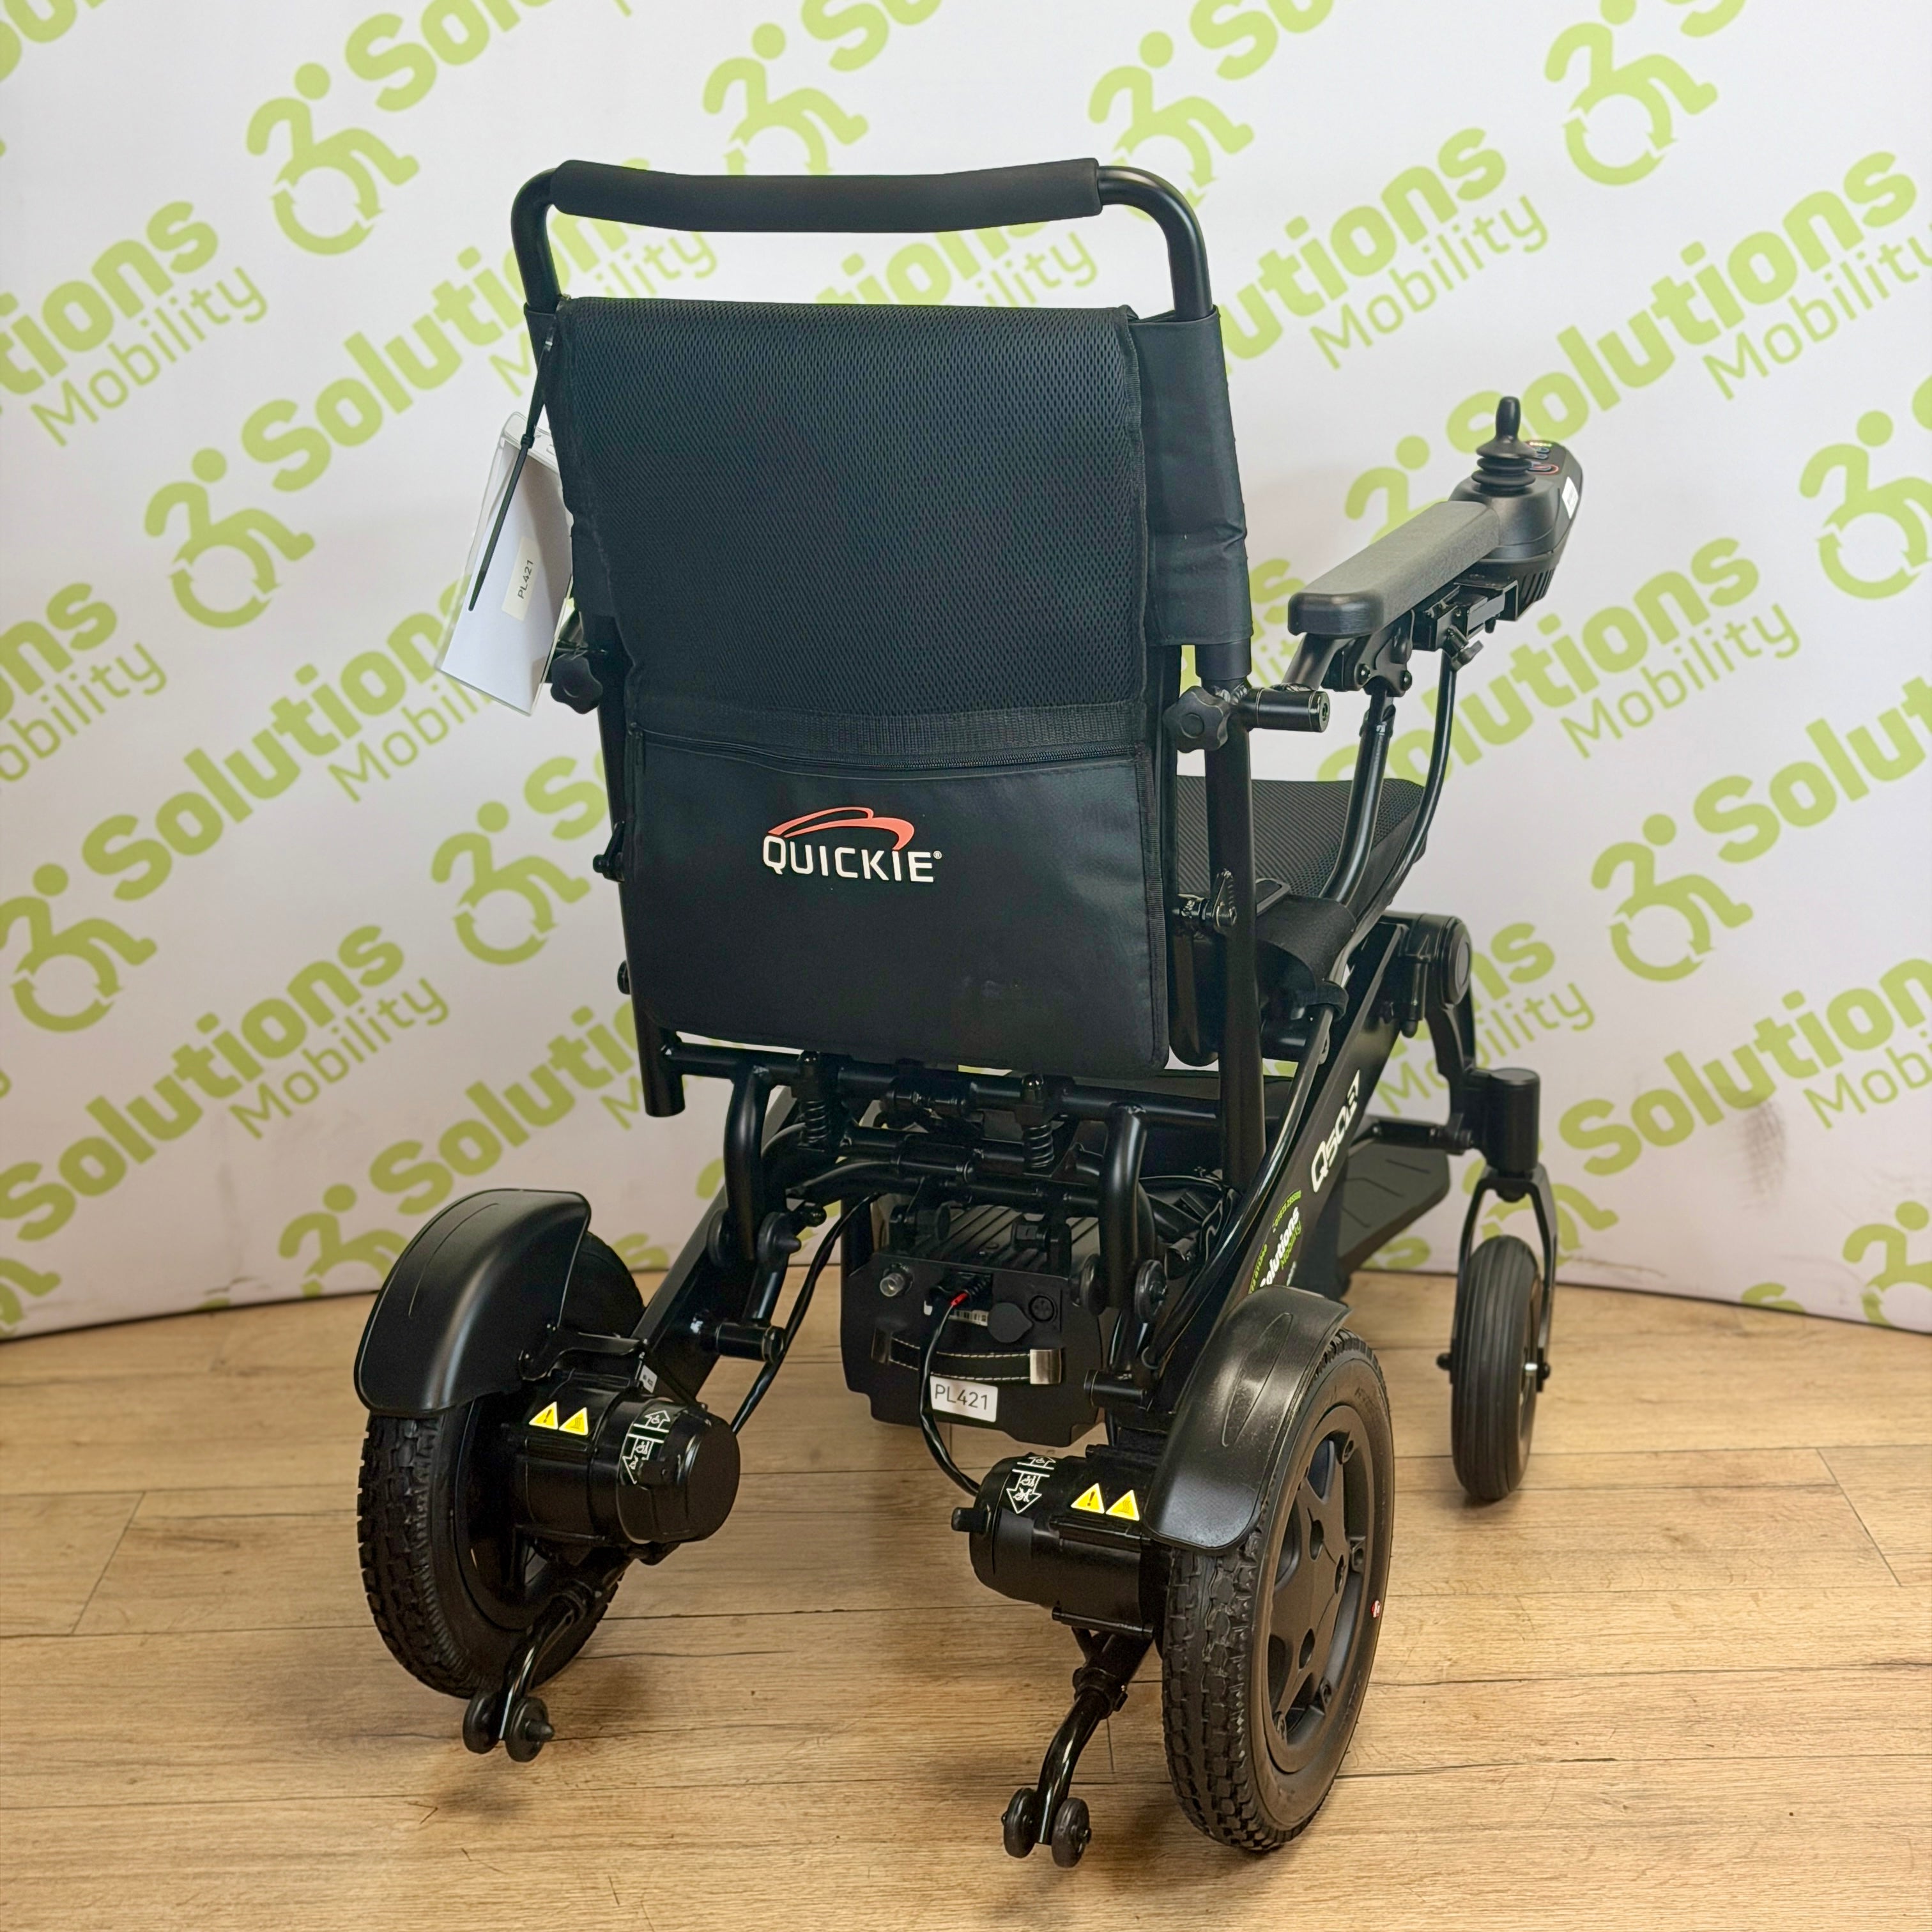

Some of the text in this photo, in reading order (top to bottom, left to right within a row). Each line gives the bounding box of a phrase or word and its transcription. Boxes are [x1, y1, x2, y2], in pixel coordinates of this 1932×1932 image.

[1217, 128, 1506, 375] utions
[1310, 196, 1549, 369] Mobility
[29, 267, 268, 447] Mobility
[517, 559, 534, 599] PL421
[0, 643, 167, 783] obility
[327, 674, 493, 803] Mobil
[1560, 604, 1800, 760] Mobility
[1692, 675, 1932, 865] Solut
[0, 925, 405, 1241] Solutions
[229, 977, 450, 1140] Mobility
[369, 1000, 639, 1216] Soluti
[1558, 958, 1932, 1177] Solution
[934, 1383, 989, 1411] PL421
